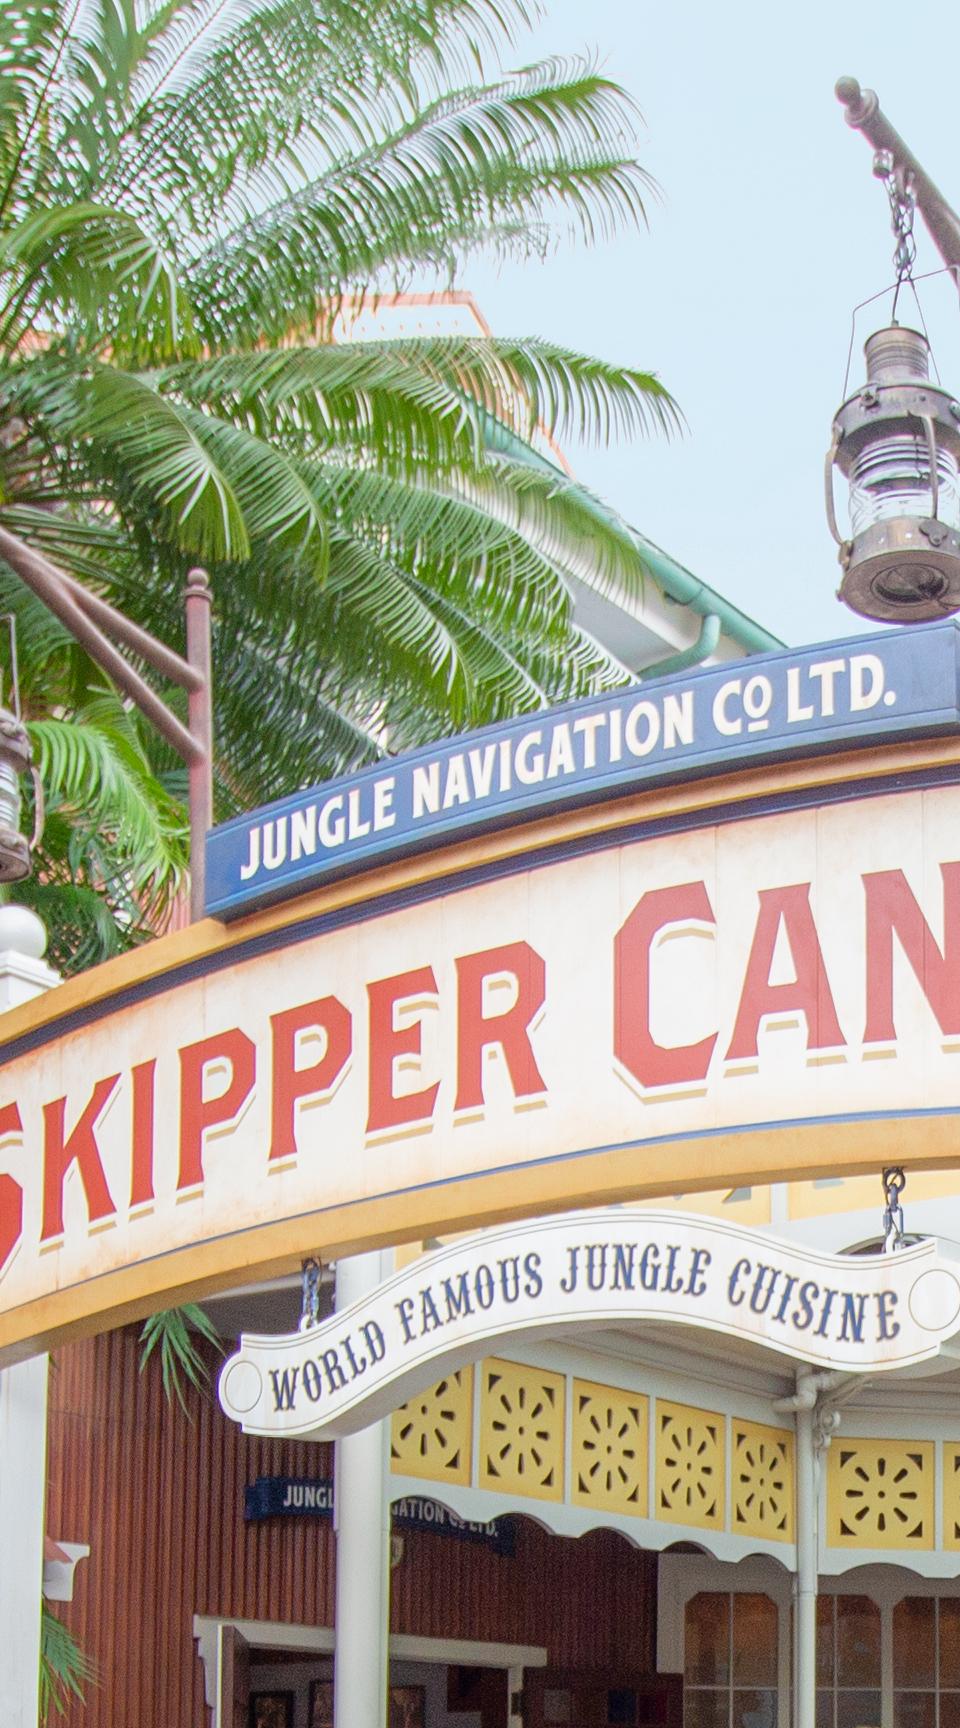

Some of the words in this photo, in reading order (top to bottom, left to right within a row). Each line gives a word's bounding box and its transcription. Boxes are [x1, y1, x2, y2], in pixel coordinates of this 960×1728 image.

[240, 795, 396, 881] JUNGLE
[411, 696, 694, 817] NAVIGATION
[785, 655, 897, 722] LTD.
[269, 1320, 387, 1412] WORLD
[394, 1252, 543, 1344] FAMOUS
[560, 1243, 712, 1297] JUNGLE
[728, 1258, 901, 1343] CUISINE
[283, 1485, 334, 1508] JUNGL
